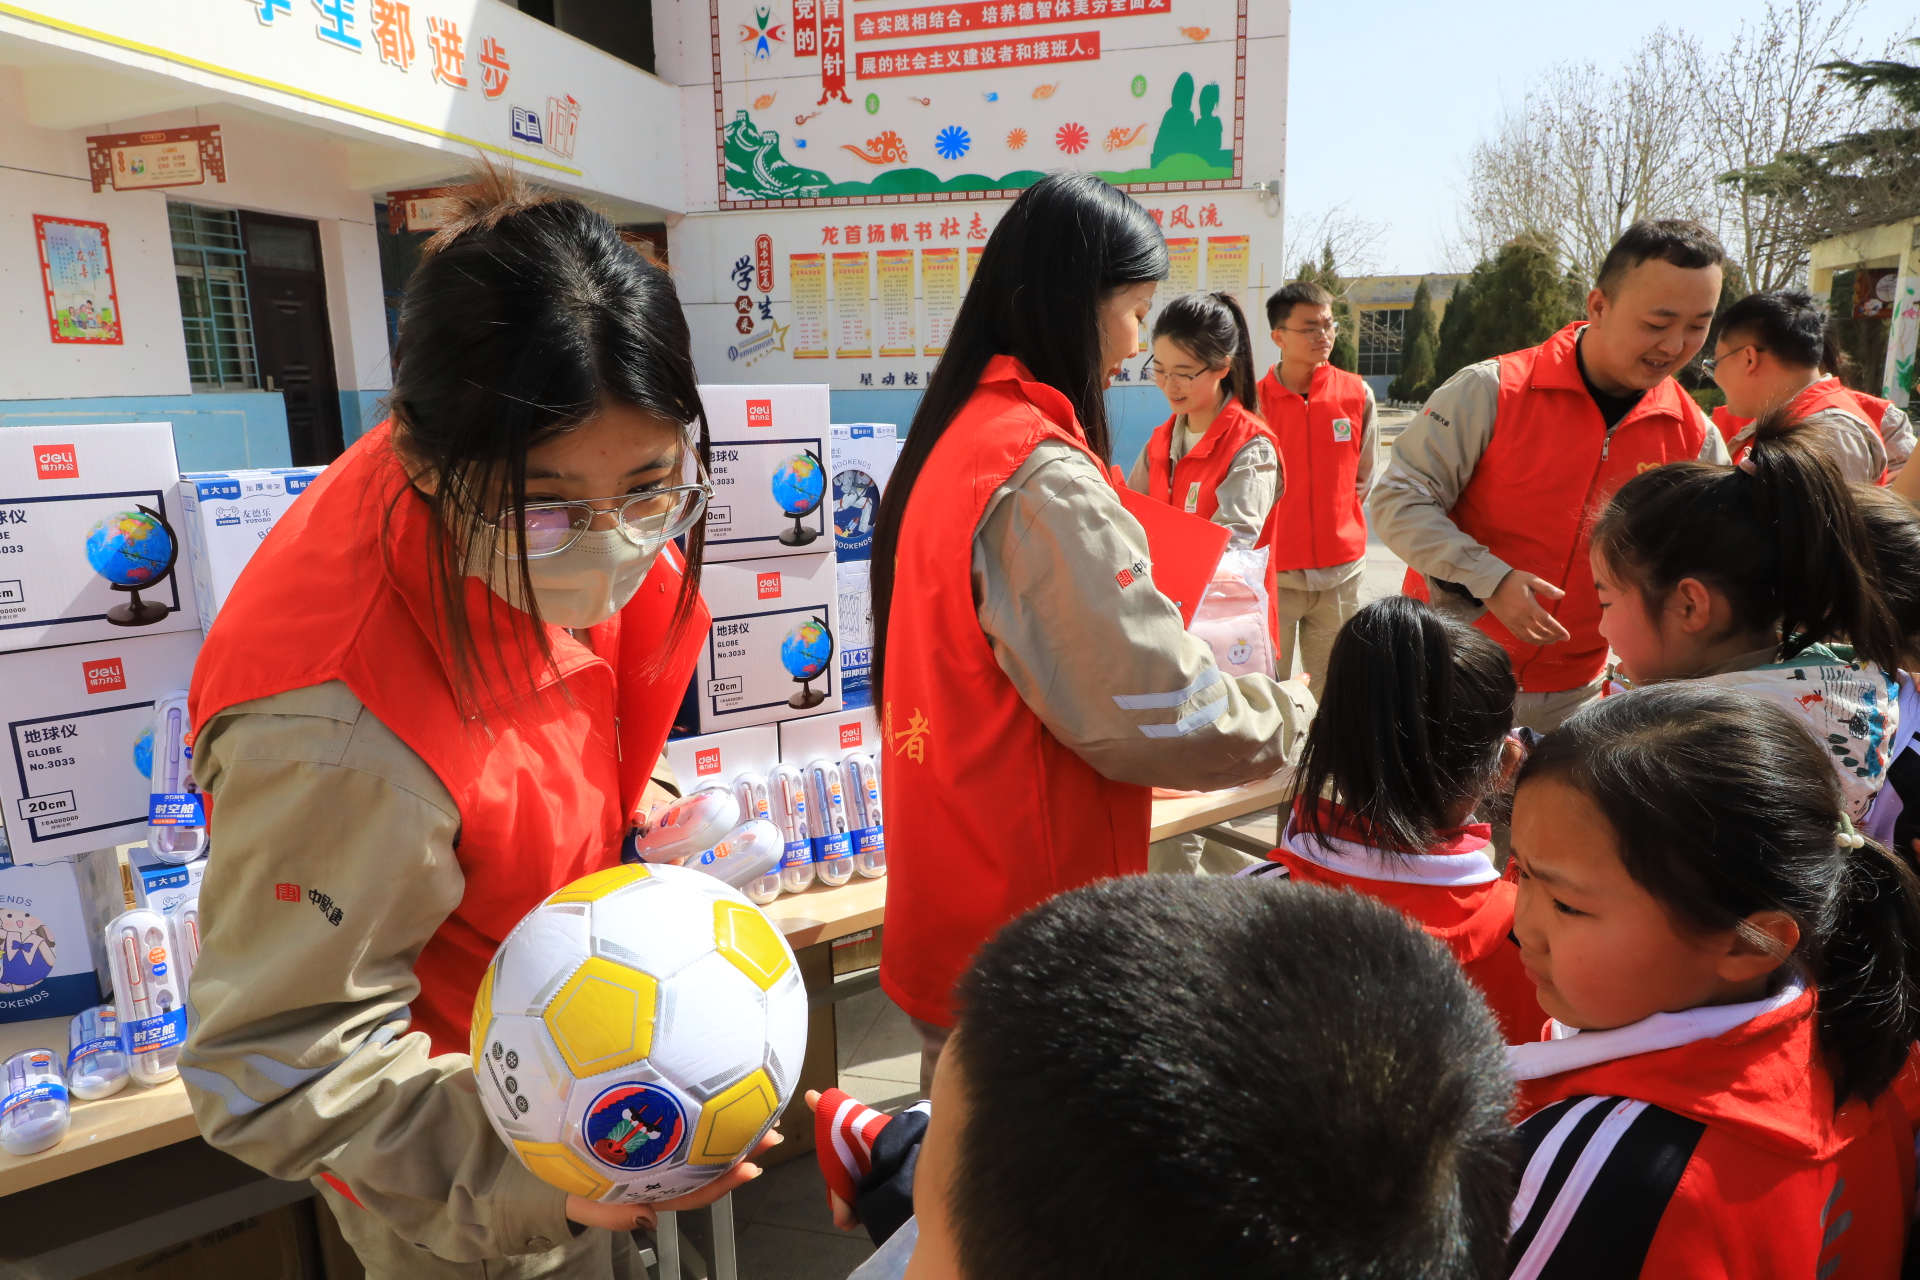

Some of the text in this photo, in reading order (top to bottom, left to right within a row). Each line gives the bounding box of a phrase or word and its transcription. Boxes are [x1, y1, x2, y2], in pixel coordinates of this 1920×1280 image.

[861, 39, 1096, 75] 展的社会主义建设者和接班人。
[821, 212, 988, 246] 龙首扬帆书壮志
[731, 255, 774, 320] 学 生
[860, 371, 934, 387] 星动校
[749, 405, 770, 415] deli
[39, 452, 73, 465] deli
[832, 458, 872, 471] BOOKENDS
[41, 462, 74, 472] 得力办公
[711, 466, 728, 474] LOBE
[711, 477, 735, 486] o.3033
[201, 486, 238, 496] 超大容量
[242, 508, 272, 518] 友德乐
[707, 511, 726, 520] 0cm
[835, 536, 873, 549] BOOKENDS
[0, 545, 24, 554] 033
[759, 577, 779, 588] deli
[716, 622, 749, 637] 地球仪
[717, 639, 739, 648] GLOBE
[718, 649, 746, 659] No.3033
[88, 665, 121, 678] deli
[89, 675, 122, 686] 得力办公
[713, 683, 737, 692] 20cm
[24, 723, 78, 744] 地球仪
[841, 726, 860, 738] deli
[27, 745, 63, 758] GLOBE
[30, 757, 76, 771] No.3033
[698, 753, 719, 764] deli
[28, 799, 67, 813] 20cm
[155, 803, 195, 815] 时空舱
[148, 873, 187, 888] 超大容量
[133, 1022, 176, 1042] 时空舱
